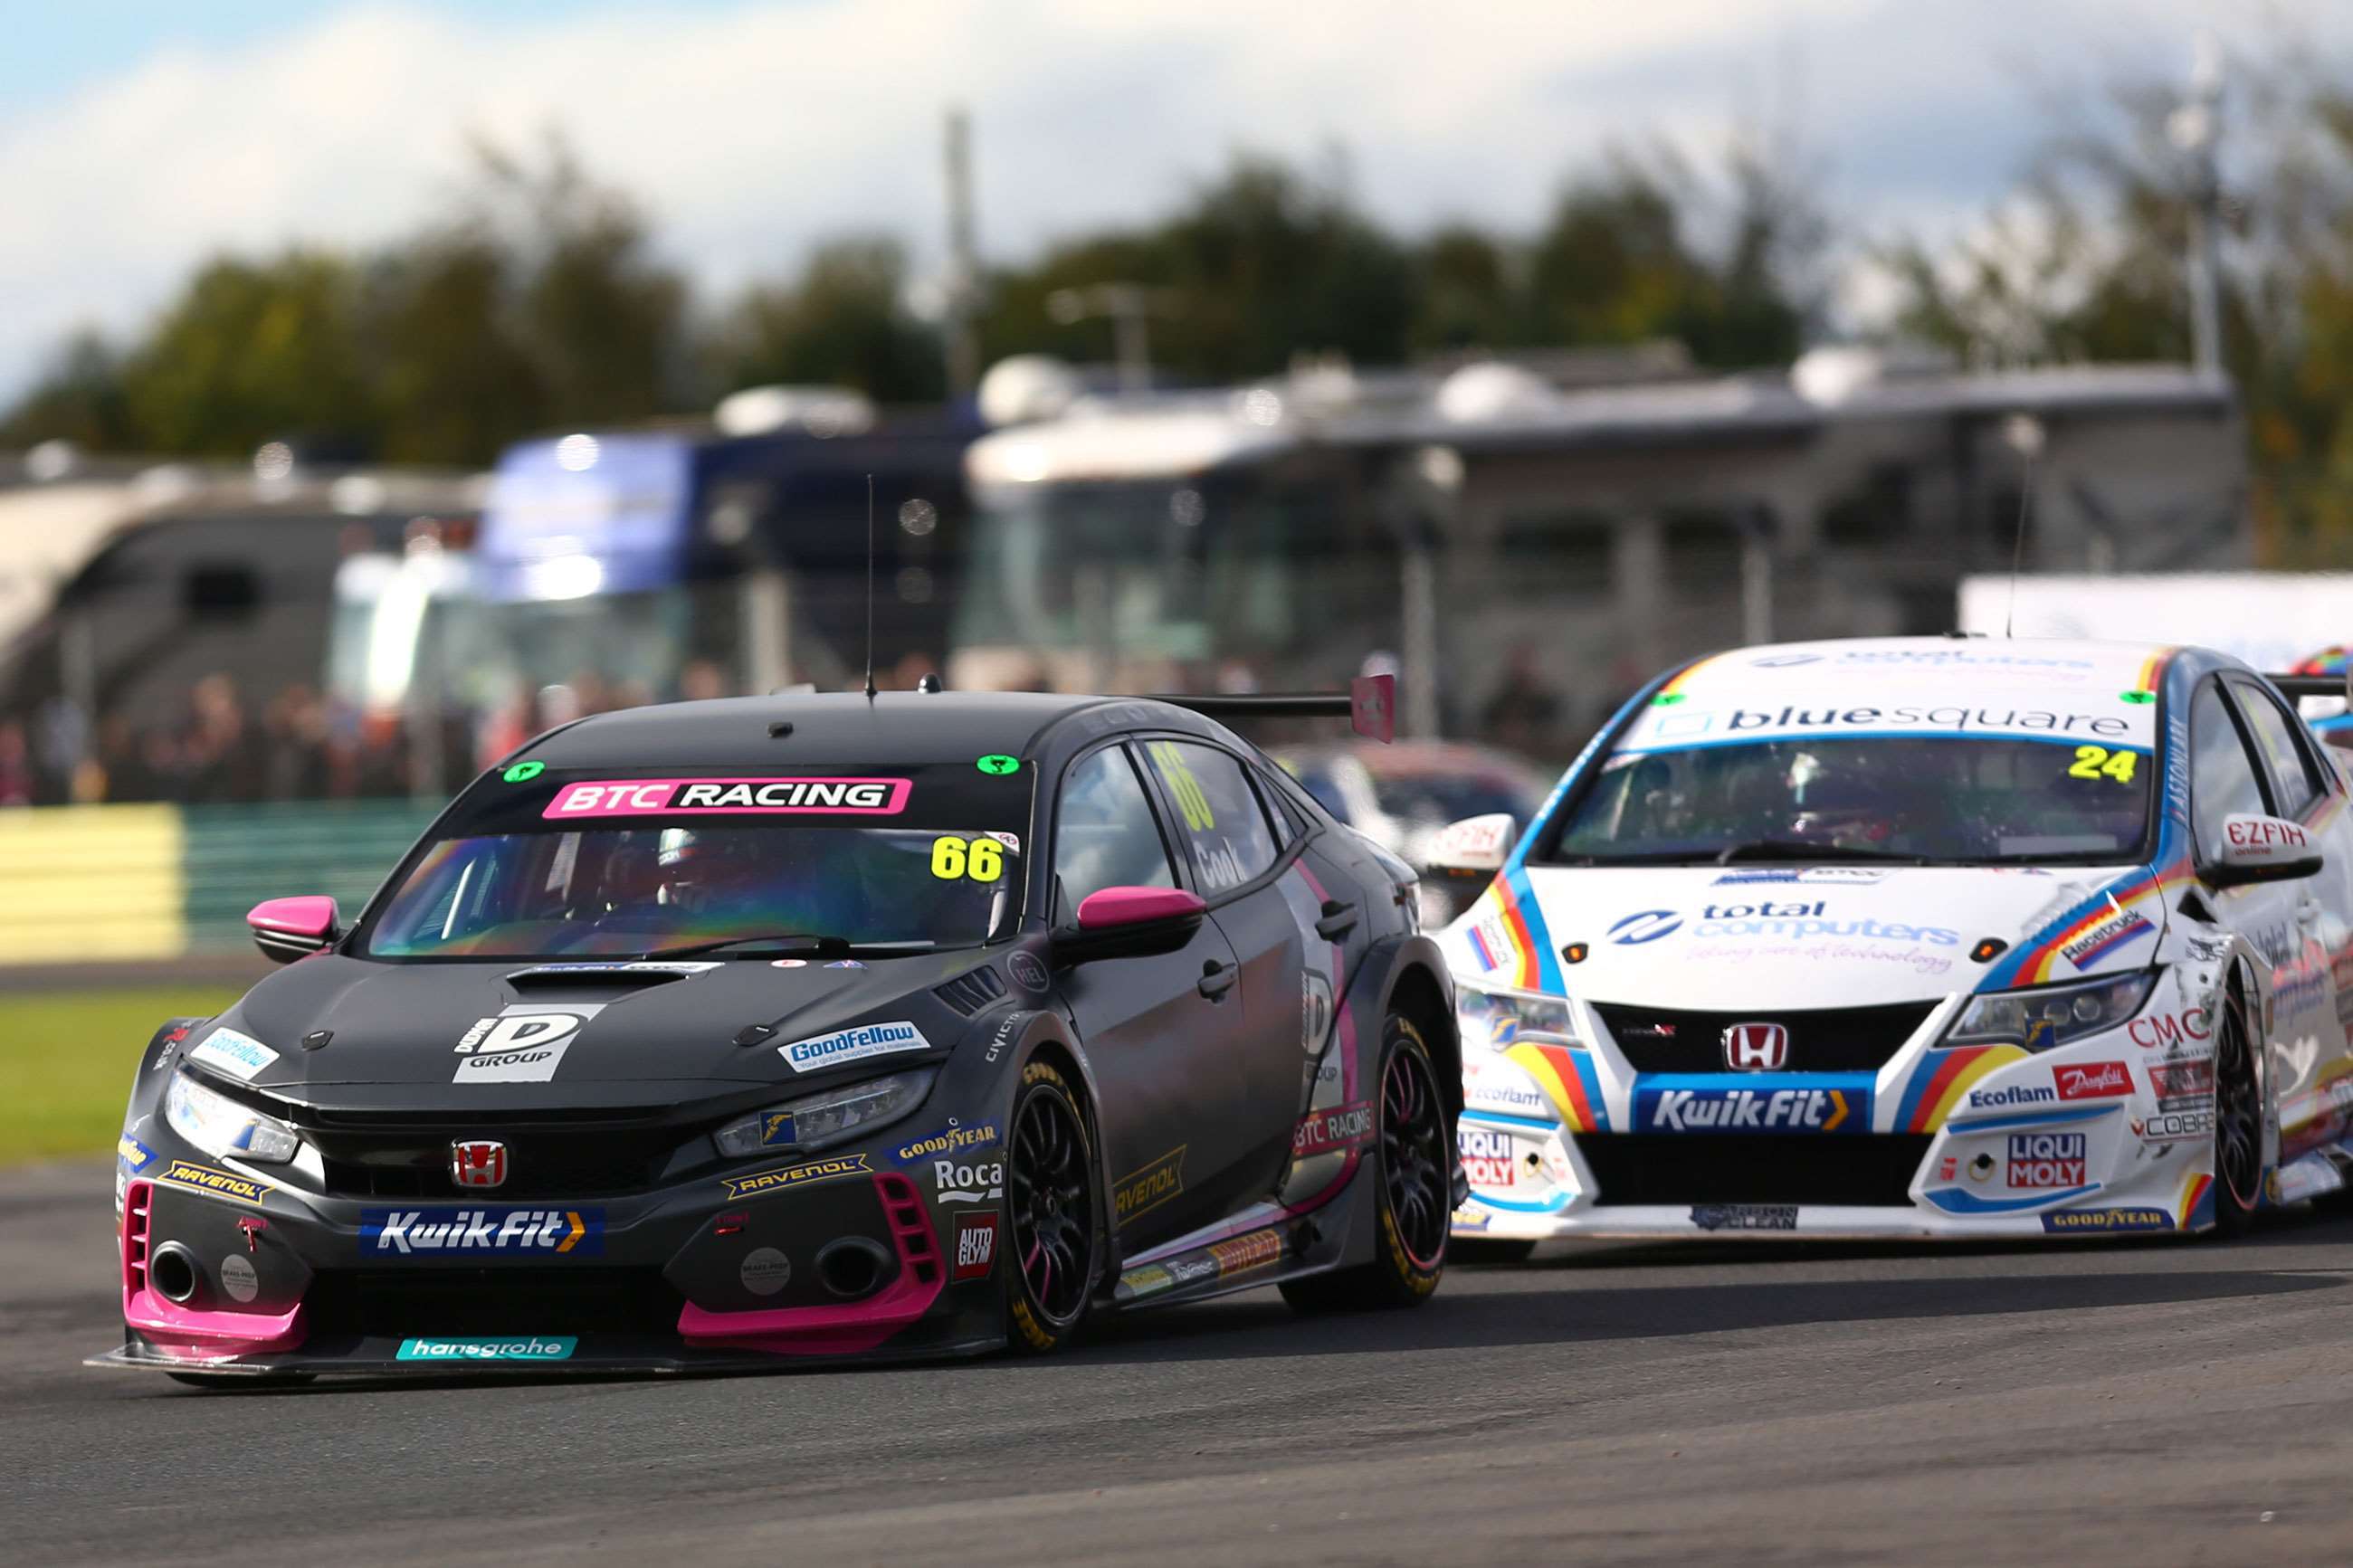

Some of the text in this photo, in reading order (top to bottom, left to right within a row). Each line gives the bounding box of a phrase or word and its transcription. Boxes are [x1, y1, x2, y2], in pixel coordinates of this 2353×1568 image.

[2068, 745, 2139, 784] 24
[560, 782, 888, 812] BTC RACING
[1150, 740, 1215, 832] 66
[930, 835, 1004, 883] 66
[1194, 837, 1248, 889] Cook
[1702, 900, 1826, 920] total
[1692, 918, 1961, 947] computers
[2128, 1008, 2212, 1050] CMC
[470, 1050, 552, 1069] GROUP
[1968, 1085, 2055, 1108] Ecoflam
[899, 1125, 996, 1160] GOODYEAR
[2010, 1135, 2082, 1160] LIQUI
[171, 1166, 259, 1198] RAVENOL
[738, 1160, 849, 1193] RAVENOL
[933, 1160, 1003, 1189] Roca
[2009, 1161, 2084, 1186] MOLY
[1115, 1165, 1176, 1214] AVENOL
[2053, 1207, 2162, 1227] GOODYEAR
[958, 1227, 993, 1249] AUTO
[957, 1245, 992, 1267] GLYM
[411, 1337, 563, 1357] hansgrohe
